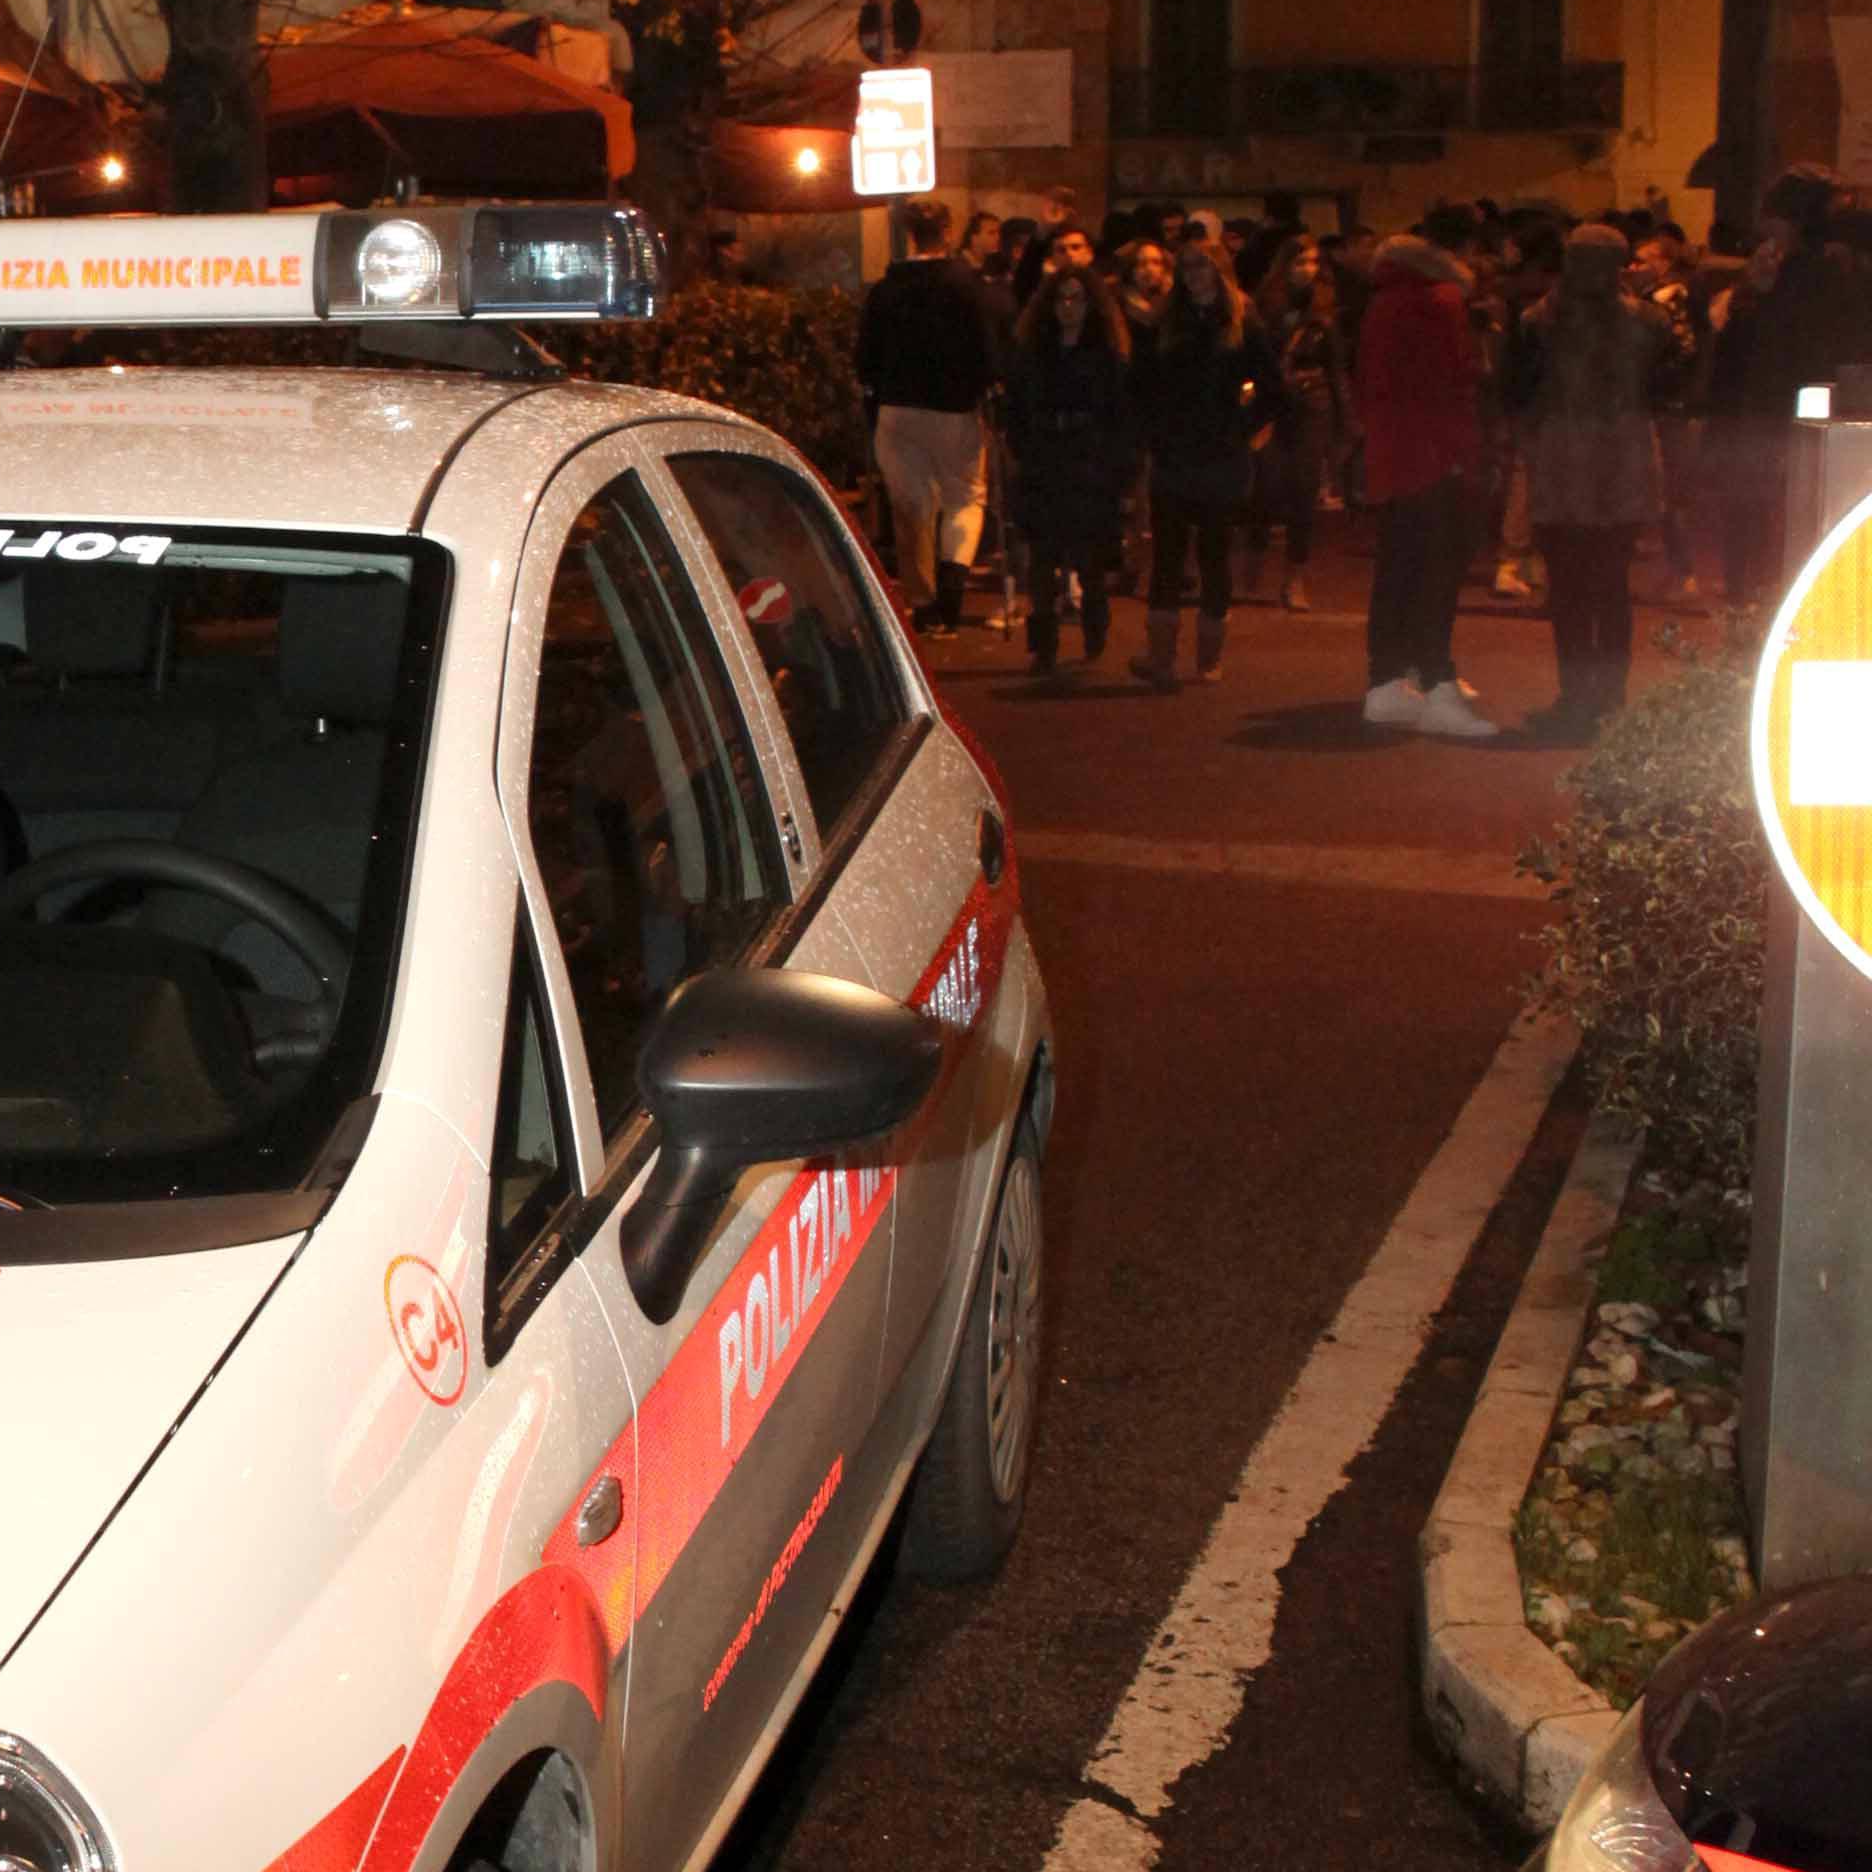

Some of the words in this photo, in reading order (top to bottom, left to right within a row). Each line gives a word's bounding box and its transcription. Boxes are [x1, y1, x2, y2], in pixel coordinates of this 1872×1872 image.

[81, 255, 302, 289] MUNICIPALE
[400, 1284, 459, 1371] C4
[719, 1168, 852, 1450] POLIZIA
